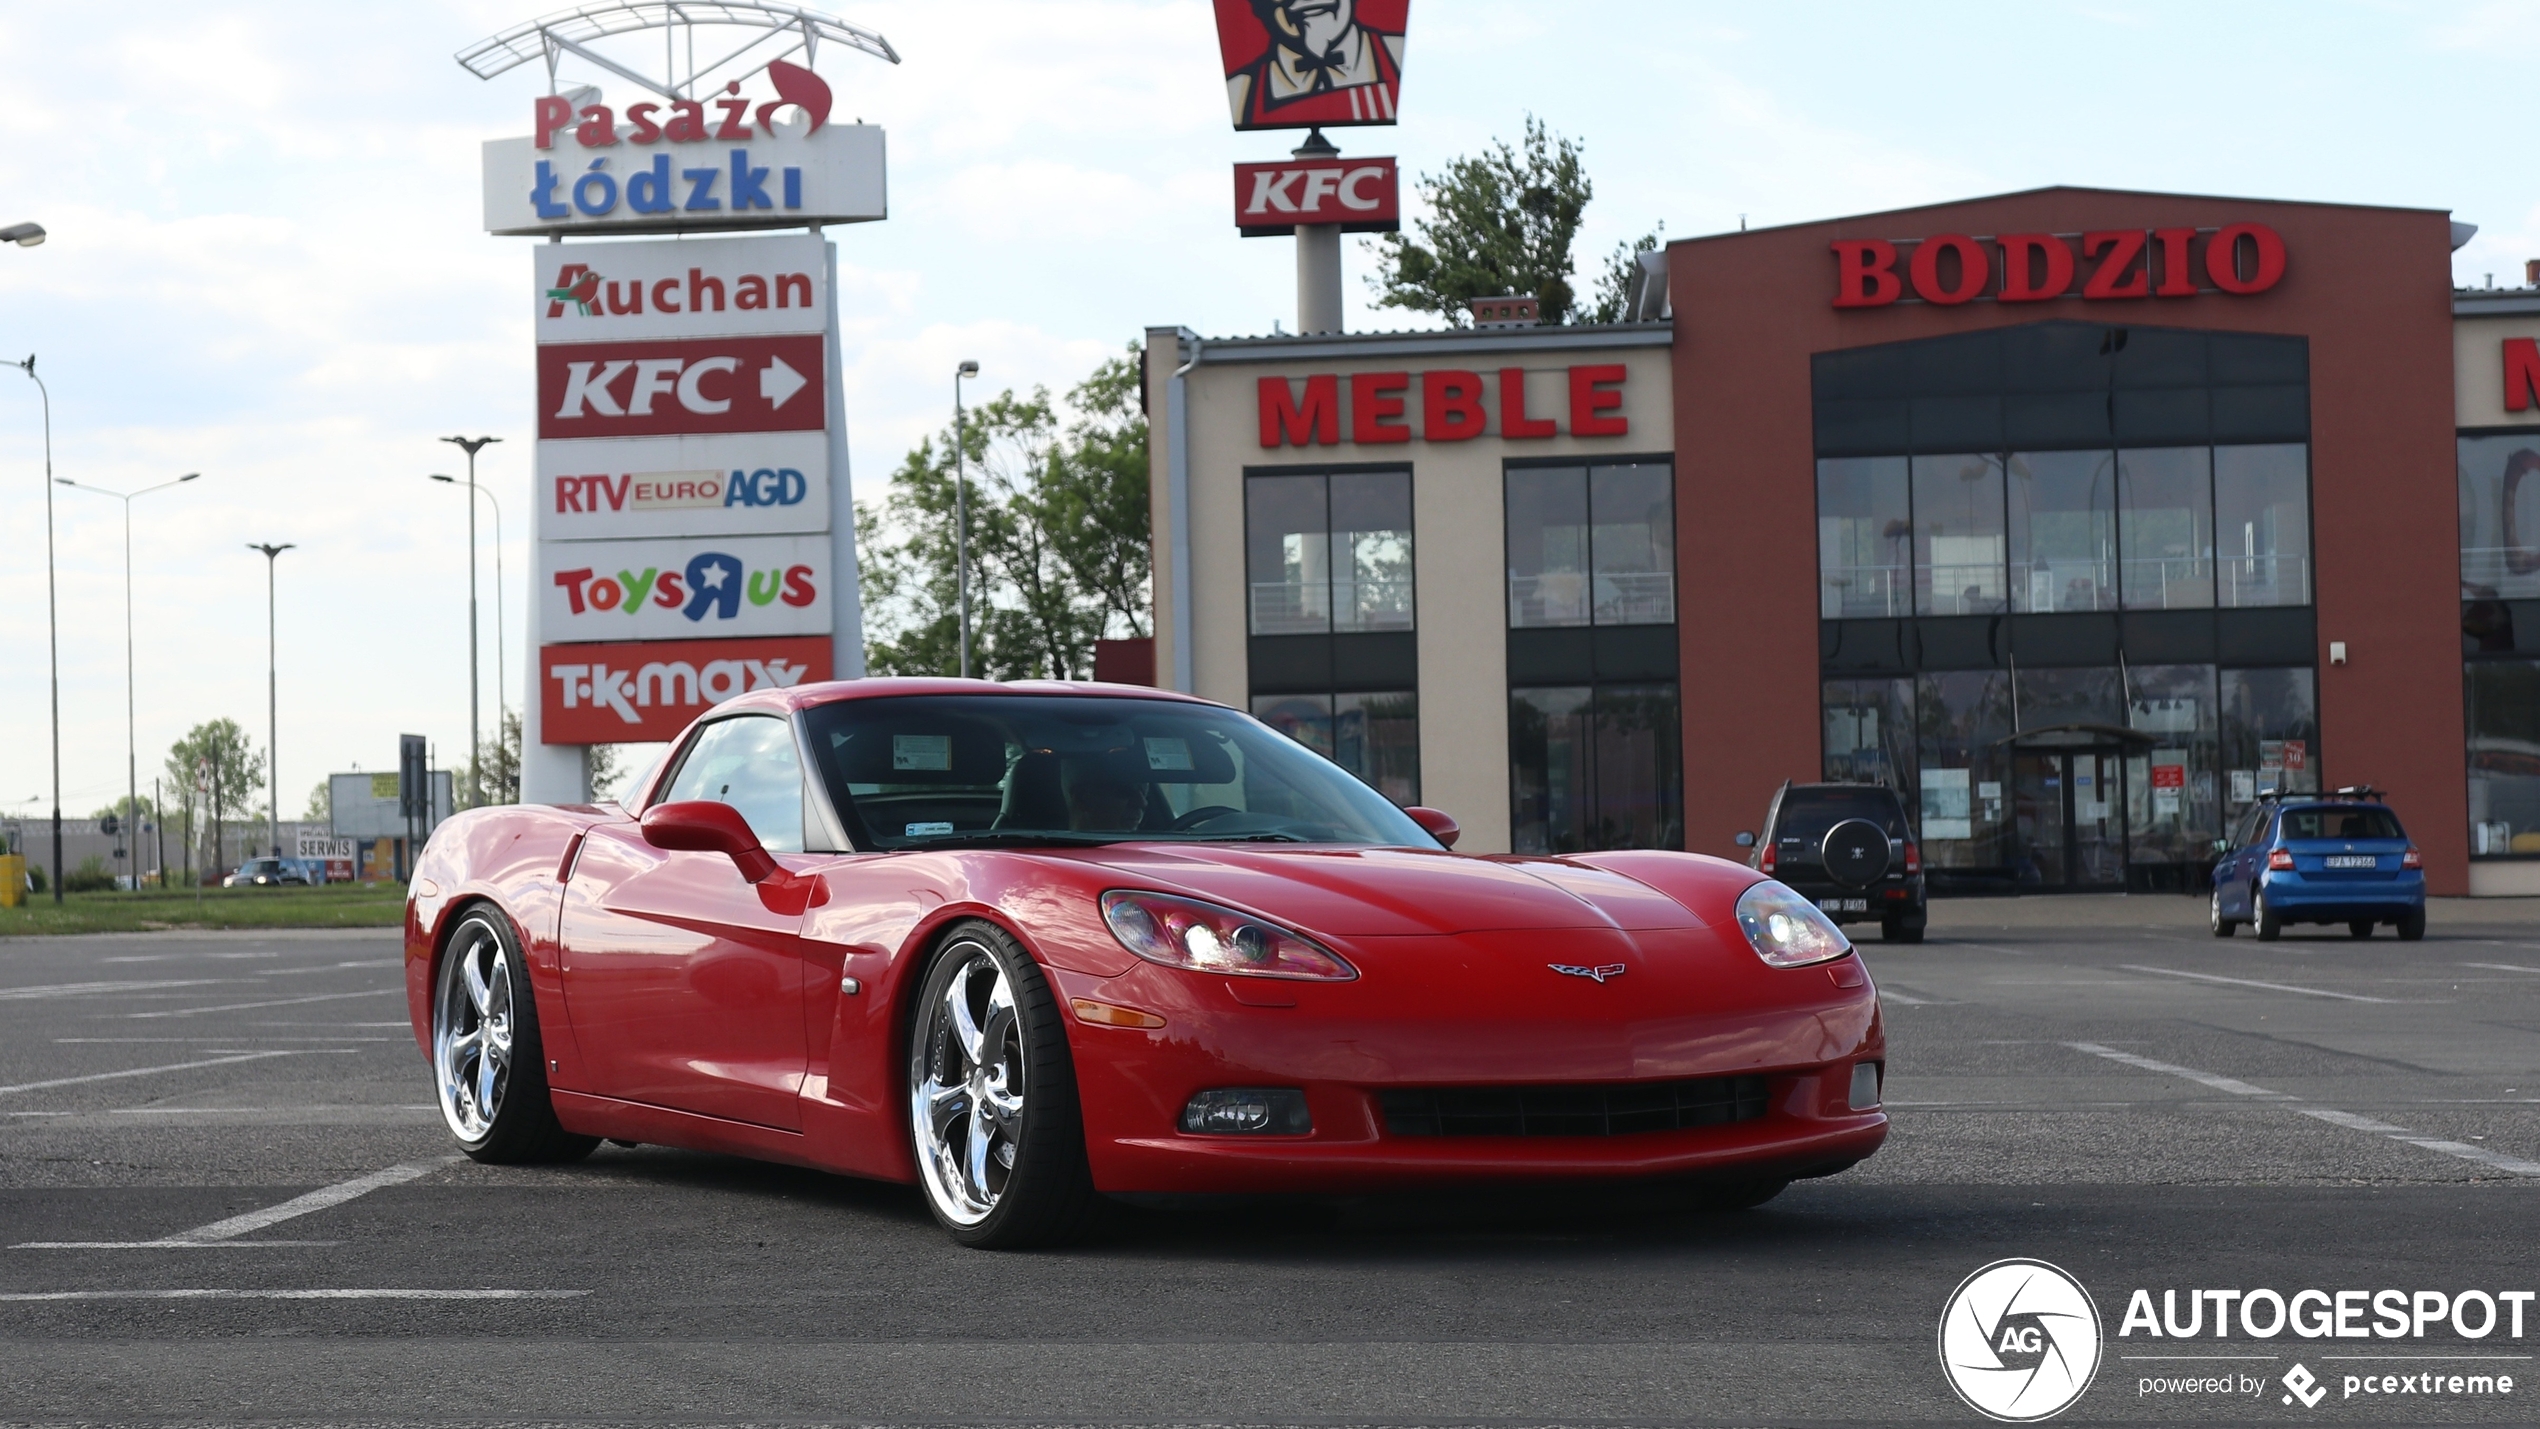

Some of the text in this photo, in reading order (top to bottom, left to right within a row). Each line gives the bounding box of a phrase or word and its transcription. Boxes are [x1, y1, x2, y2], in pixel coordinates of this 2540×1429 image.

[534, 80, 754, 149] Pasaż
[530, 149, 803, 219] Łódzki
[1245, 167, 1383, 214] KFC
[546, 263, 813, 318] Auchan
[1830, 222, 2286, 310] BODZIO
[554, 355, 738, 419] KFC
[1256, 363, 1629, 449] MEBLE
[555, 467, 807, 513] RTV EURO AGD
[300, 840, 350, 856] SERWIS
